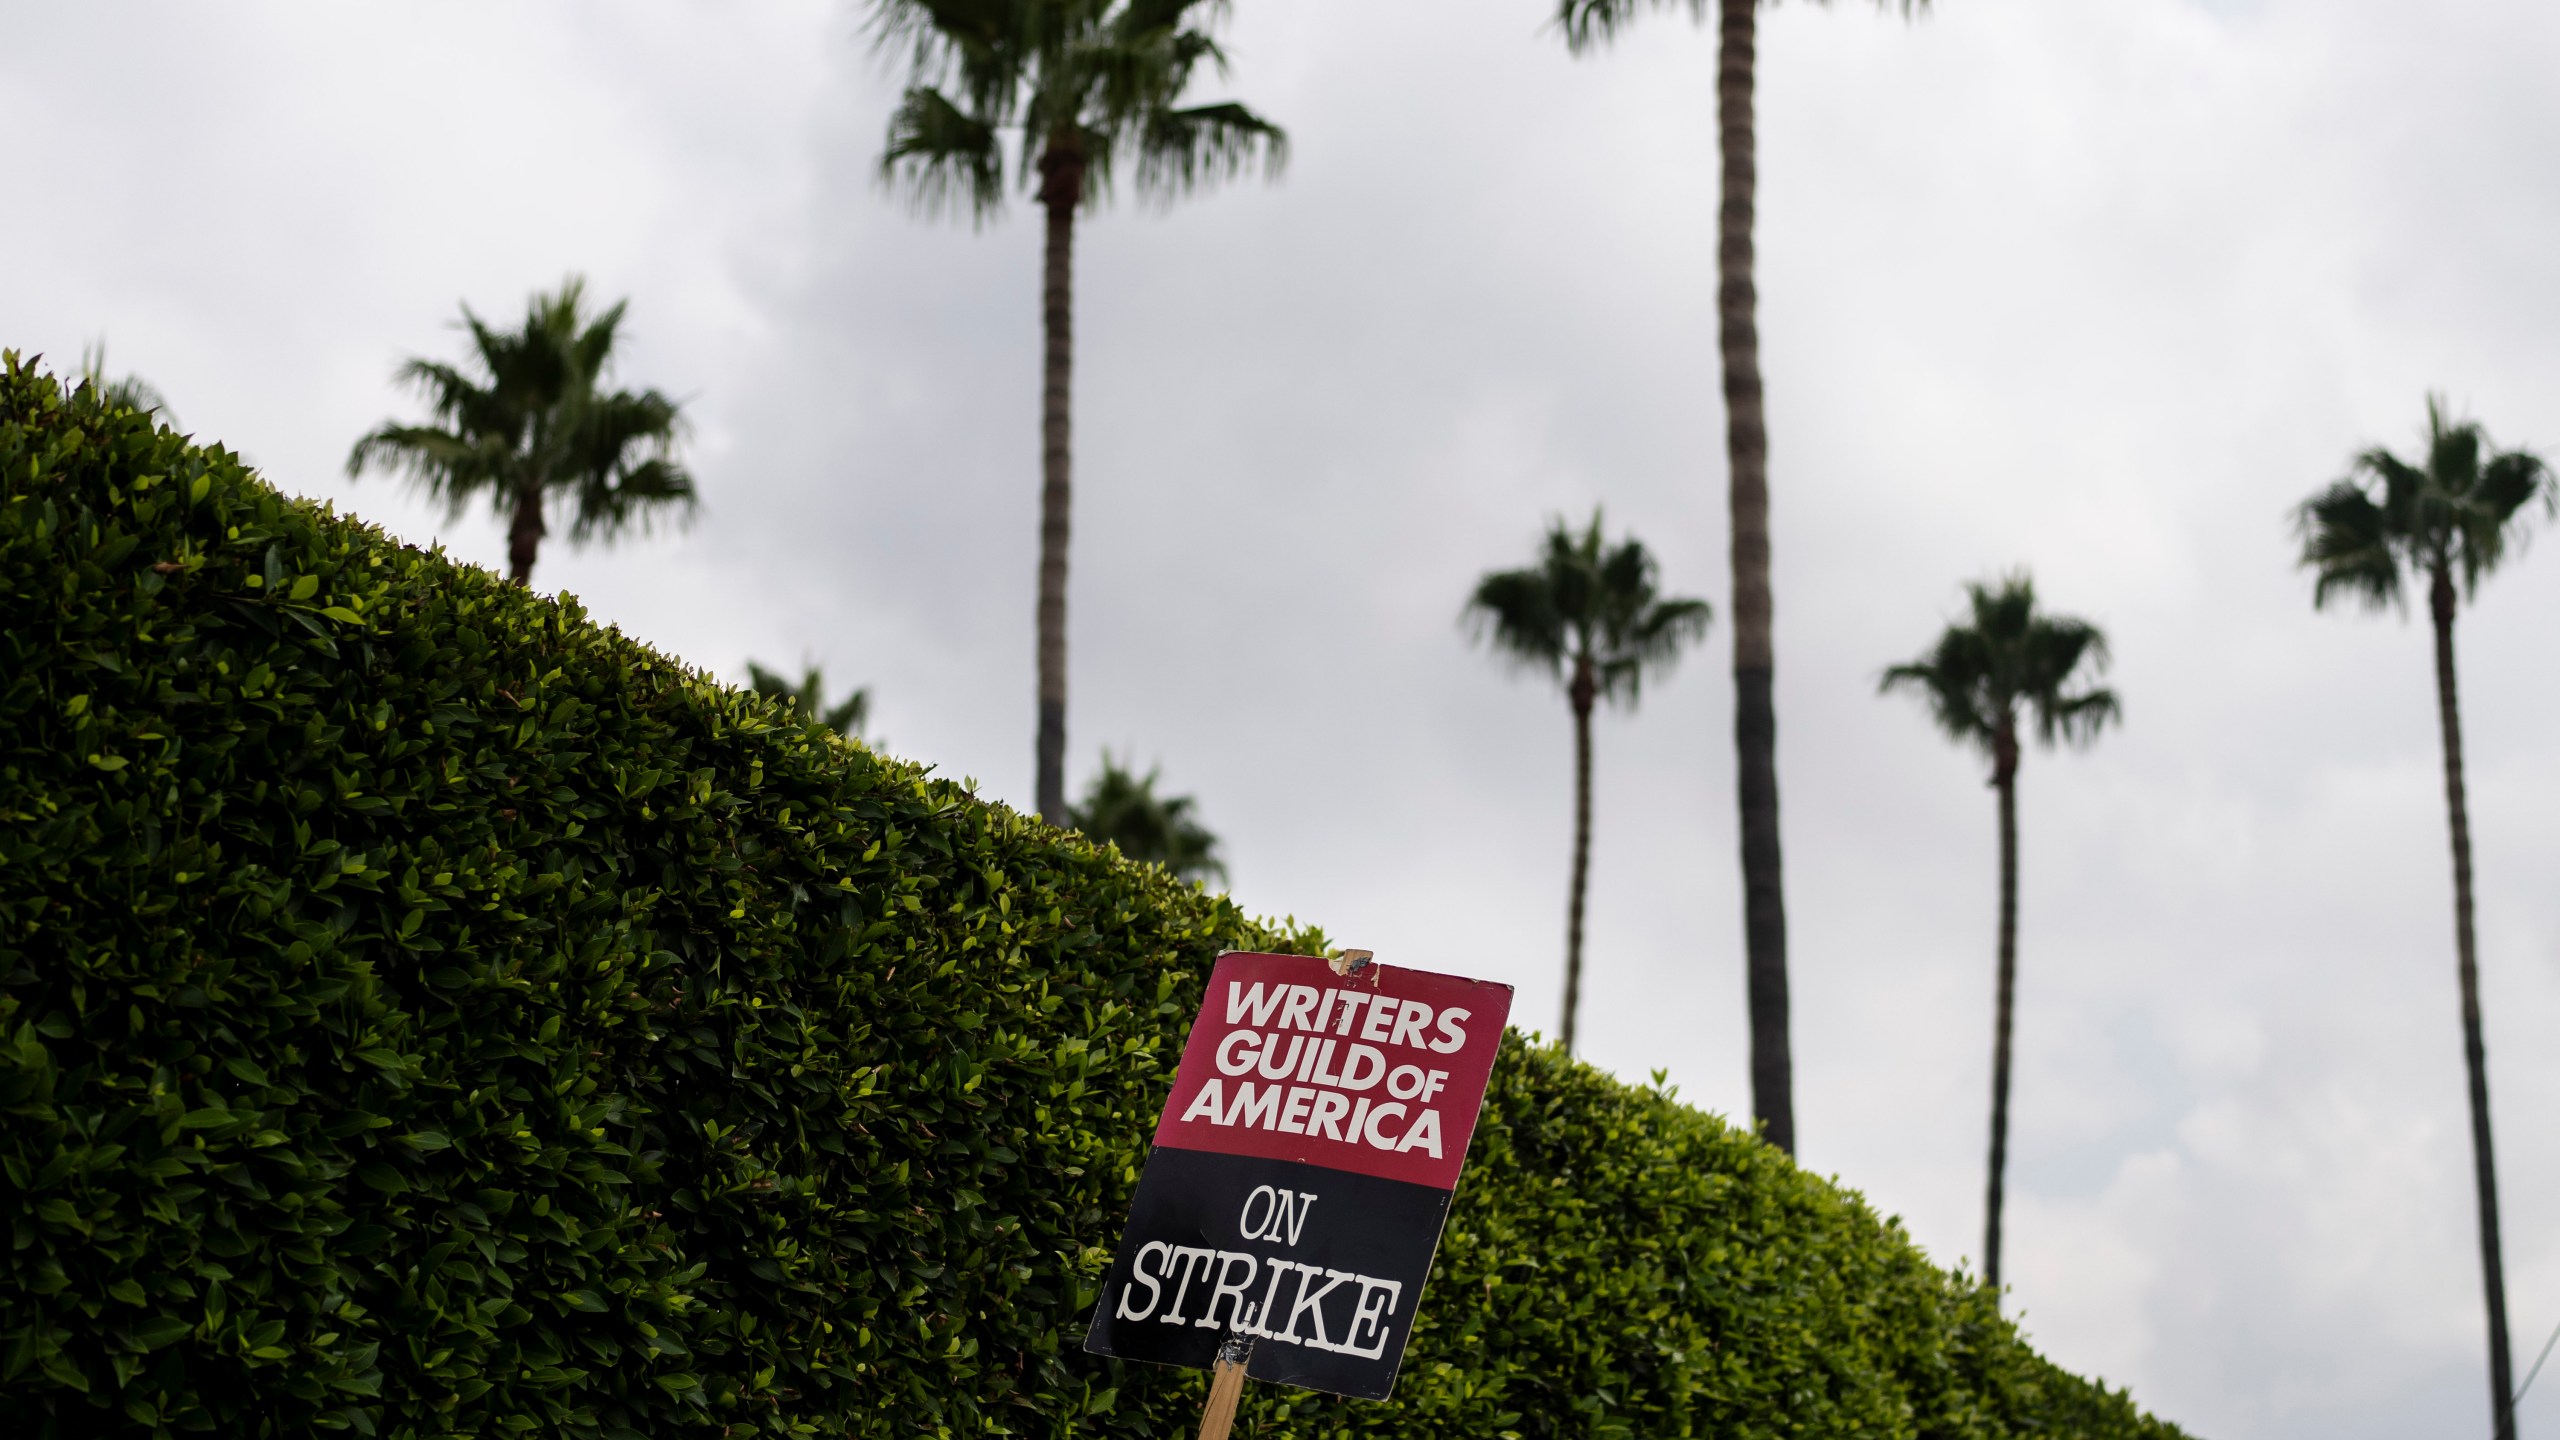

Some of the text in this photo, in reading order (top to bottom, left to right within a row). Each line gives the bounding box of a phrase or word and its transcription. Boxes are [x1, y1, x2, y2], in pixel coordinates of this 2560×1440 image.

[1226, 981, 1472, 1054] WRITERS
[1215, 1029, 1450, 1103] GUILD OF
[1180, 1078, 1443, 1160] AMERICA
[1240, 1184, 1318, 1247] ON
[1115, 1240, 1402, 1361] STRIKE
